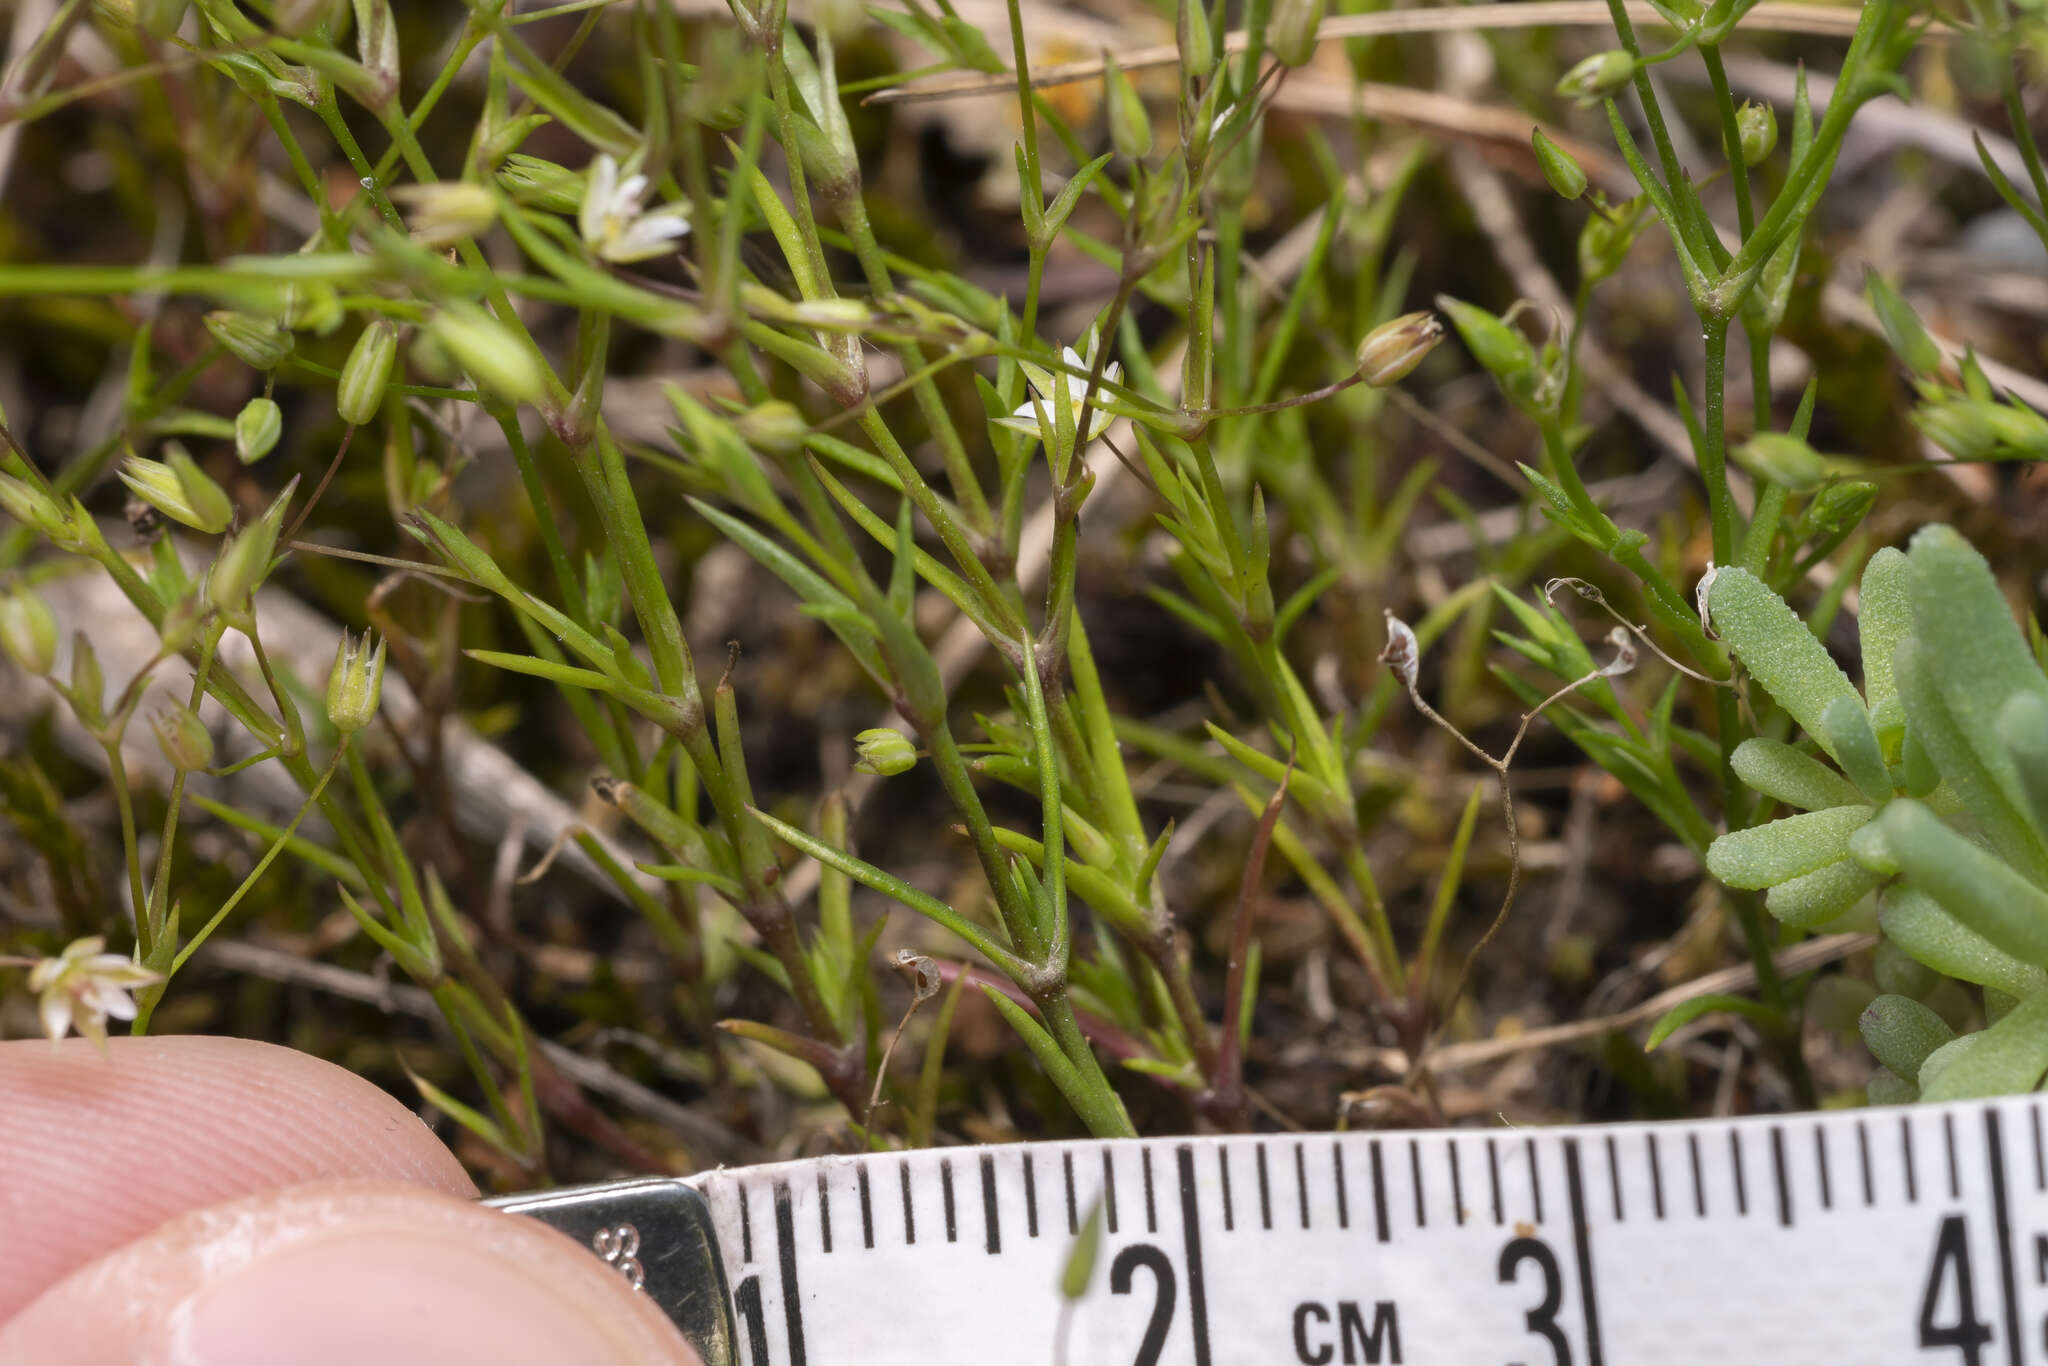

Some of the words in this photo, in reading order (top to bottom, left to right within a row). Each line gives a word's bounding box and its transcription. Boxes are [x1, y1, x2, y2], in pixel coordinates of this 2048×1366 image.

[734, 1274, 769, 1366] 1
[1110, 1244, 1176, 1366] 2
[1293, 1301, 1403, 1366] CM
[1498, 1237, 1573, 1366] 3
[1919, 1216, 1992, 1366] 4
